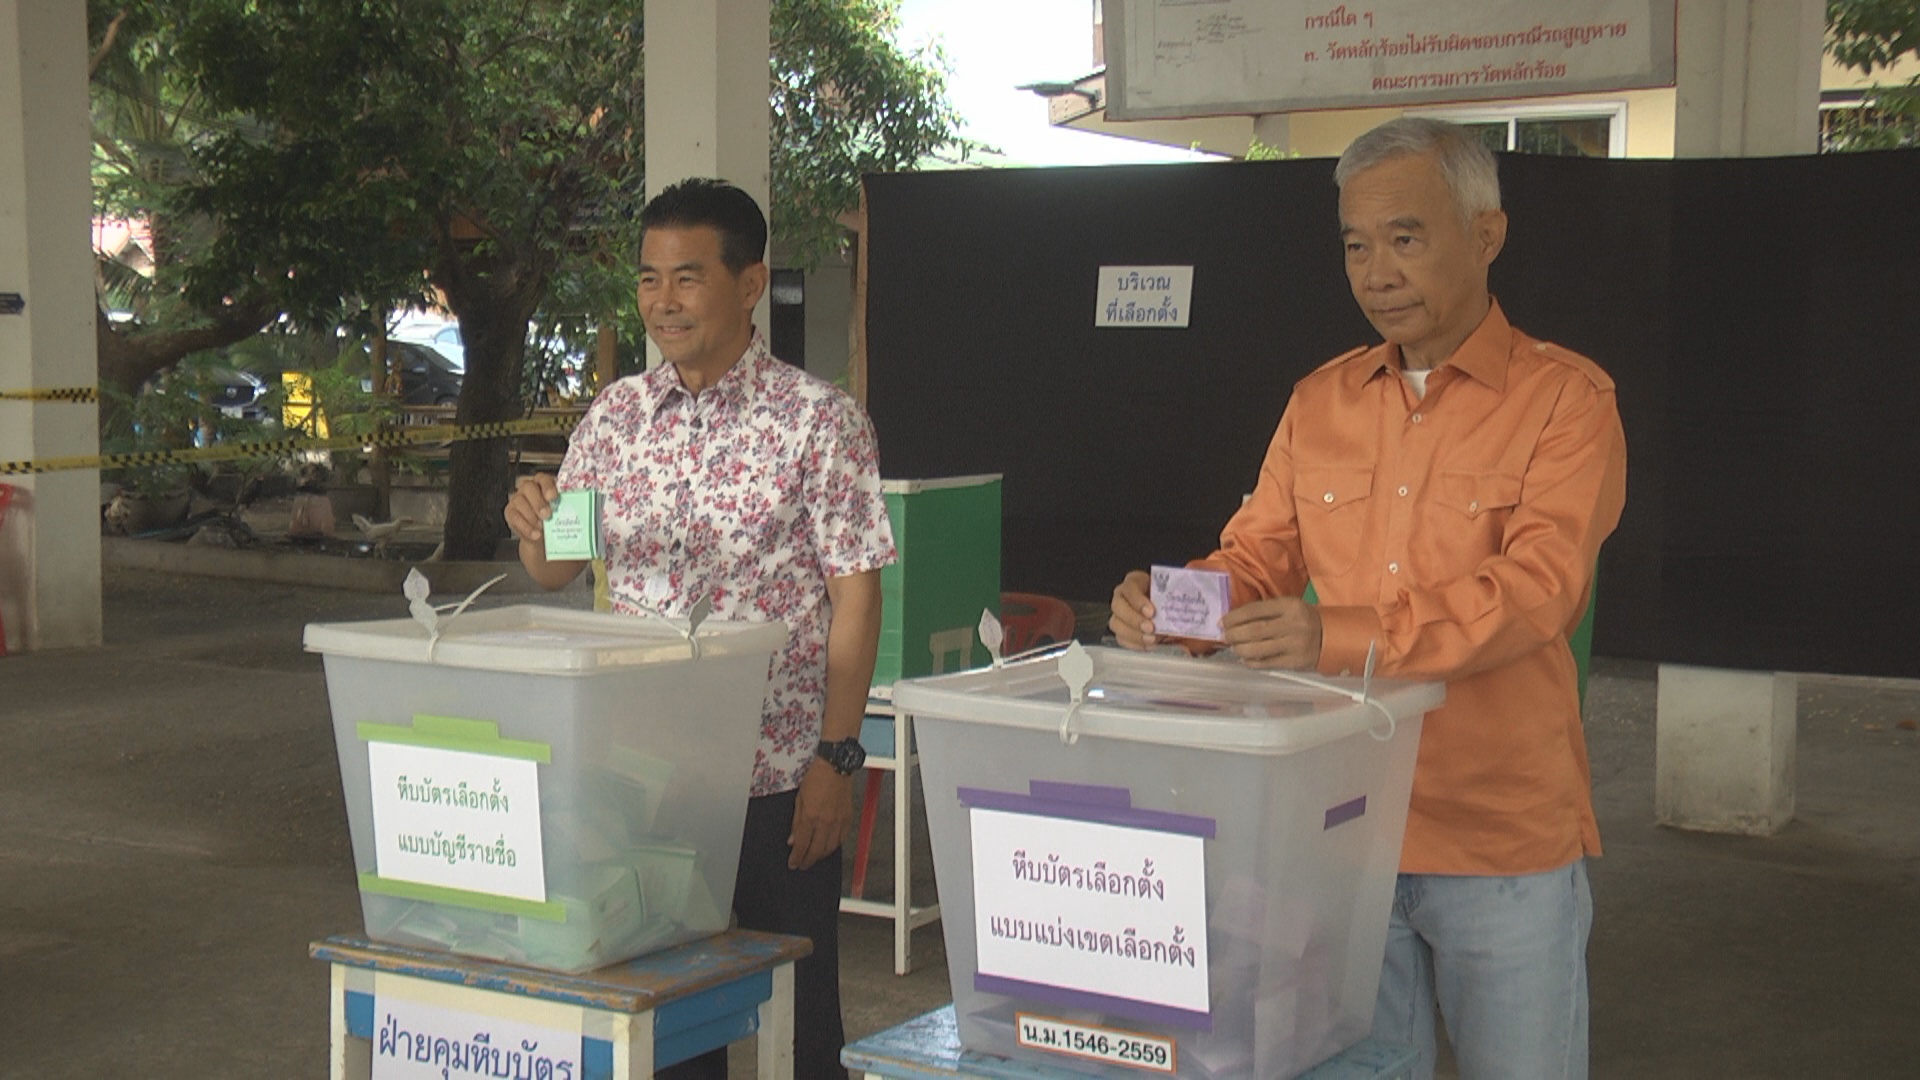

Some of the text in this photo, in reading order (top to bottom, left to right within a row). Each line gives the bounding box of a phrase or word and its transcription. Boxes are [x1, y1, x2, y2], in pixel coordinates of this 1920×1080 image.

[1304, 4, 1357, 30] กรณีใด
[1117, 271, 1171, 291] บริเวณ
[1106, 295, 1178, 322] ที่เลือกตั้ง
[397, 775, 509, 814] หีบบัตรเลือกตั้ง
[398, 830, 516, 868] แบบบัญชีรายชื่อ
[1012, 850, 1164, 901] หีบบัตรเลือกตั้ง
[990, 914, 1195, 968] แบบแบ่งเขตเลือกตั้ง
[379, 1013, 574, 1080] ฝ่ายคุมหีบบัตร
[1023, 1023, 1166, 1065] น.ม.1546-2559
